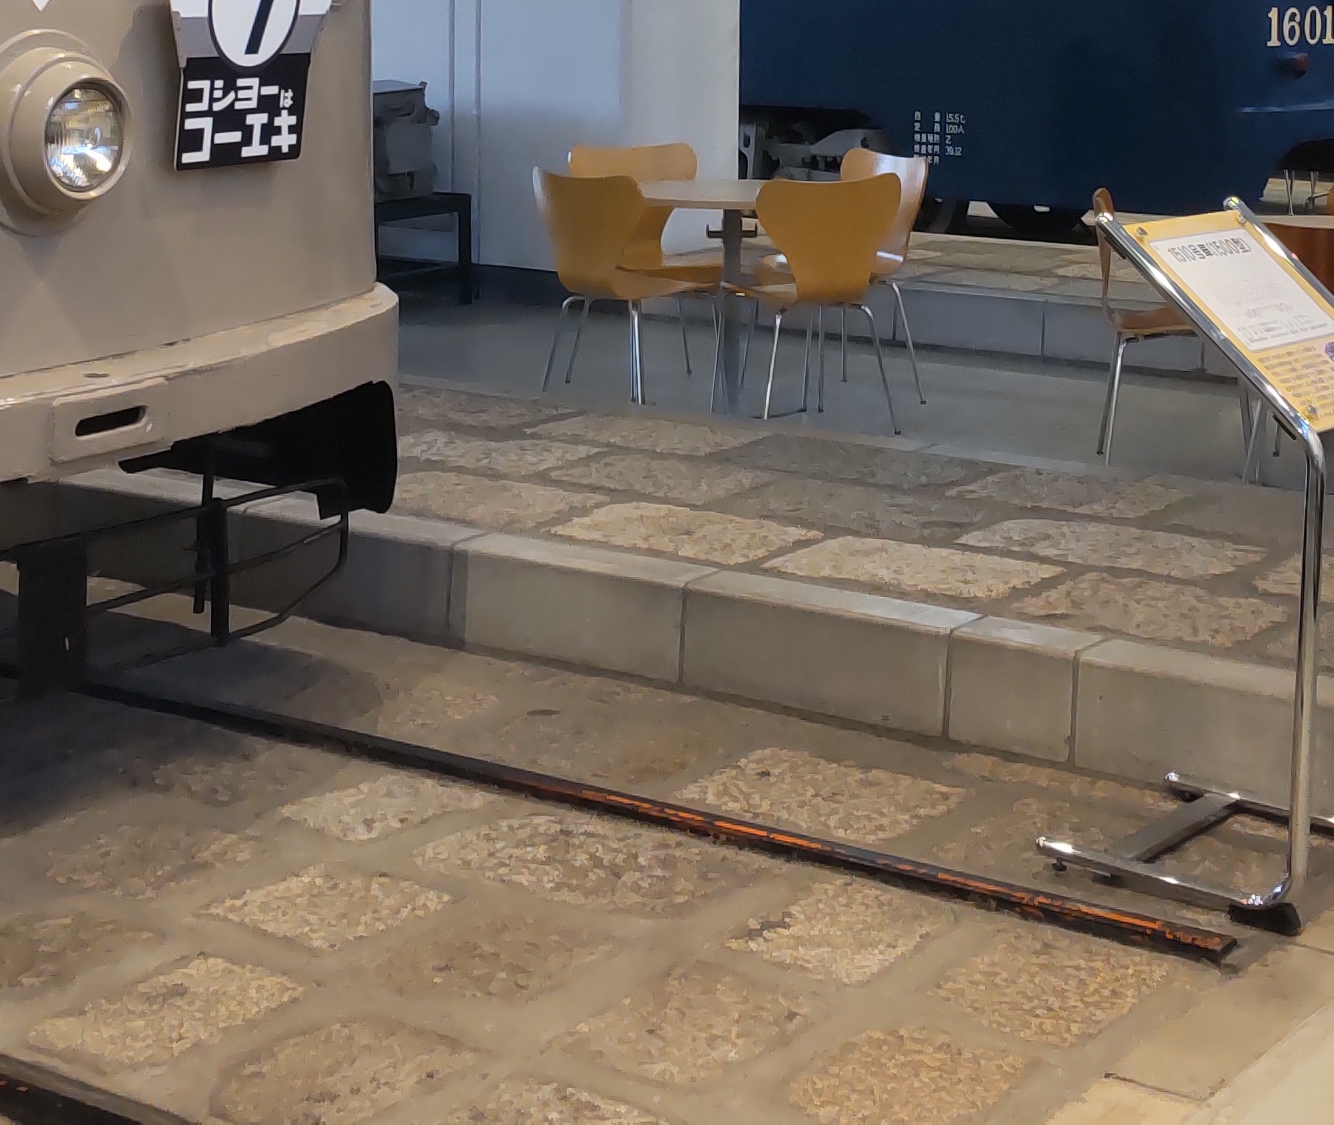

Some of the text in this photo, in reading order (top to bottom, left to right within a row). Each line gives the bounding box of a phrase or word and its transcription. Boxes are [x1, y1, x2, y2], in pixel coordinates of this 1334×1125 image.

[1266, 5, 1334, 46] 1601
[181, 110, 298, 163] コーエキ
